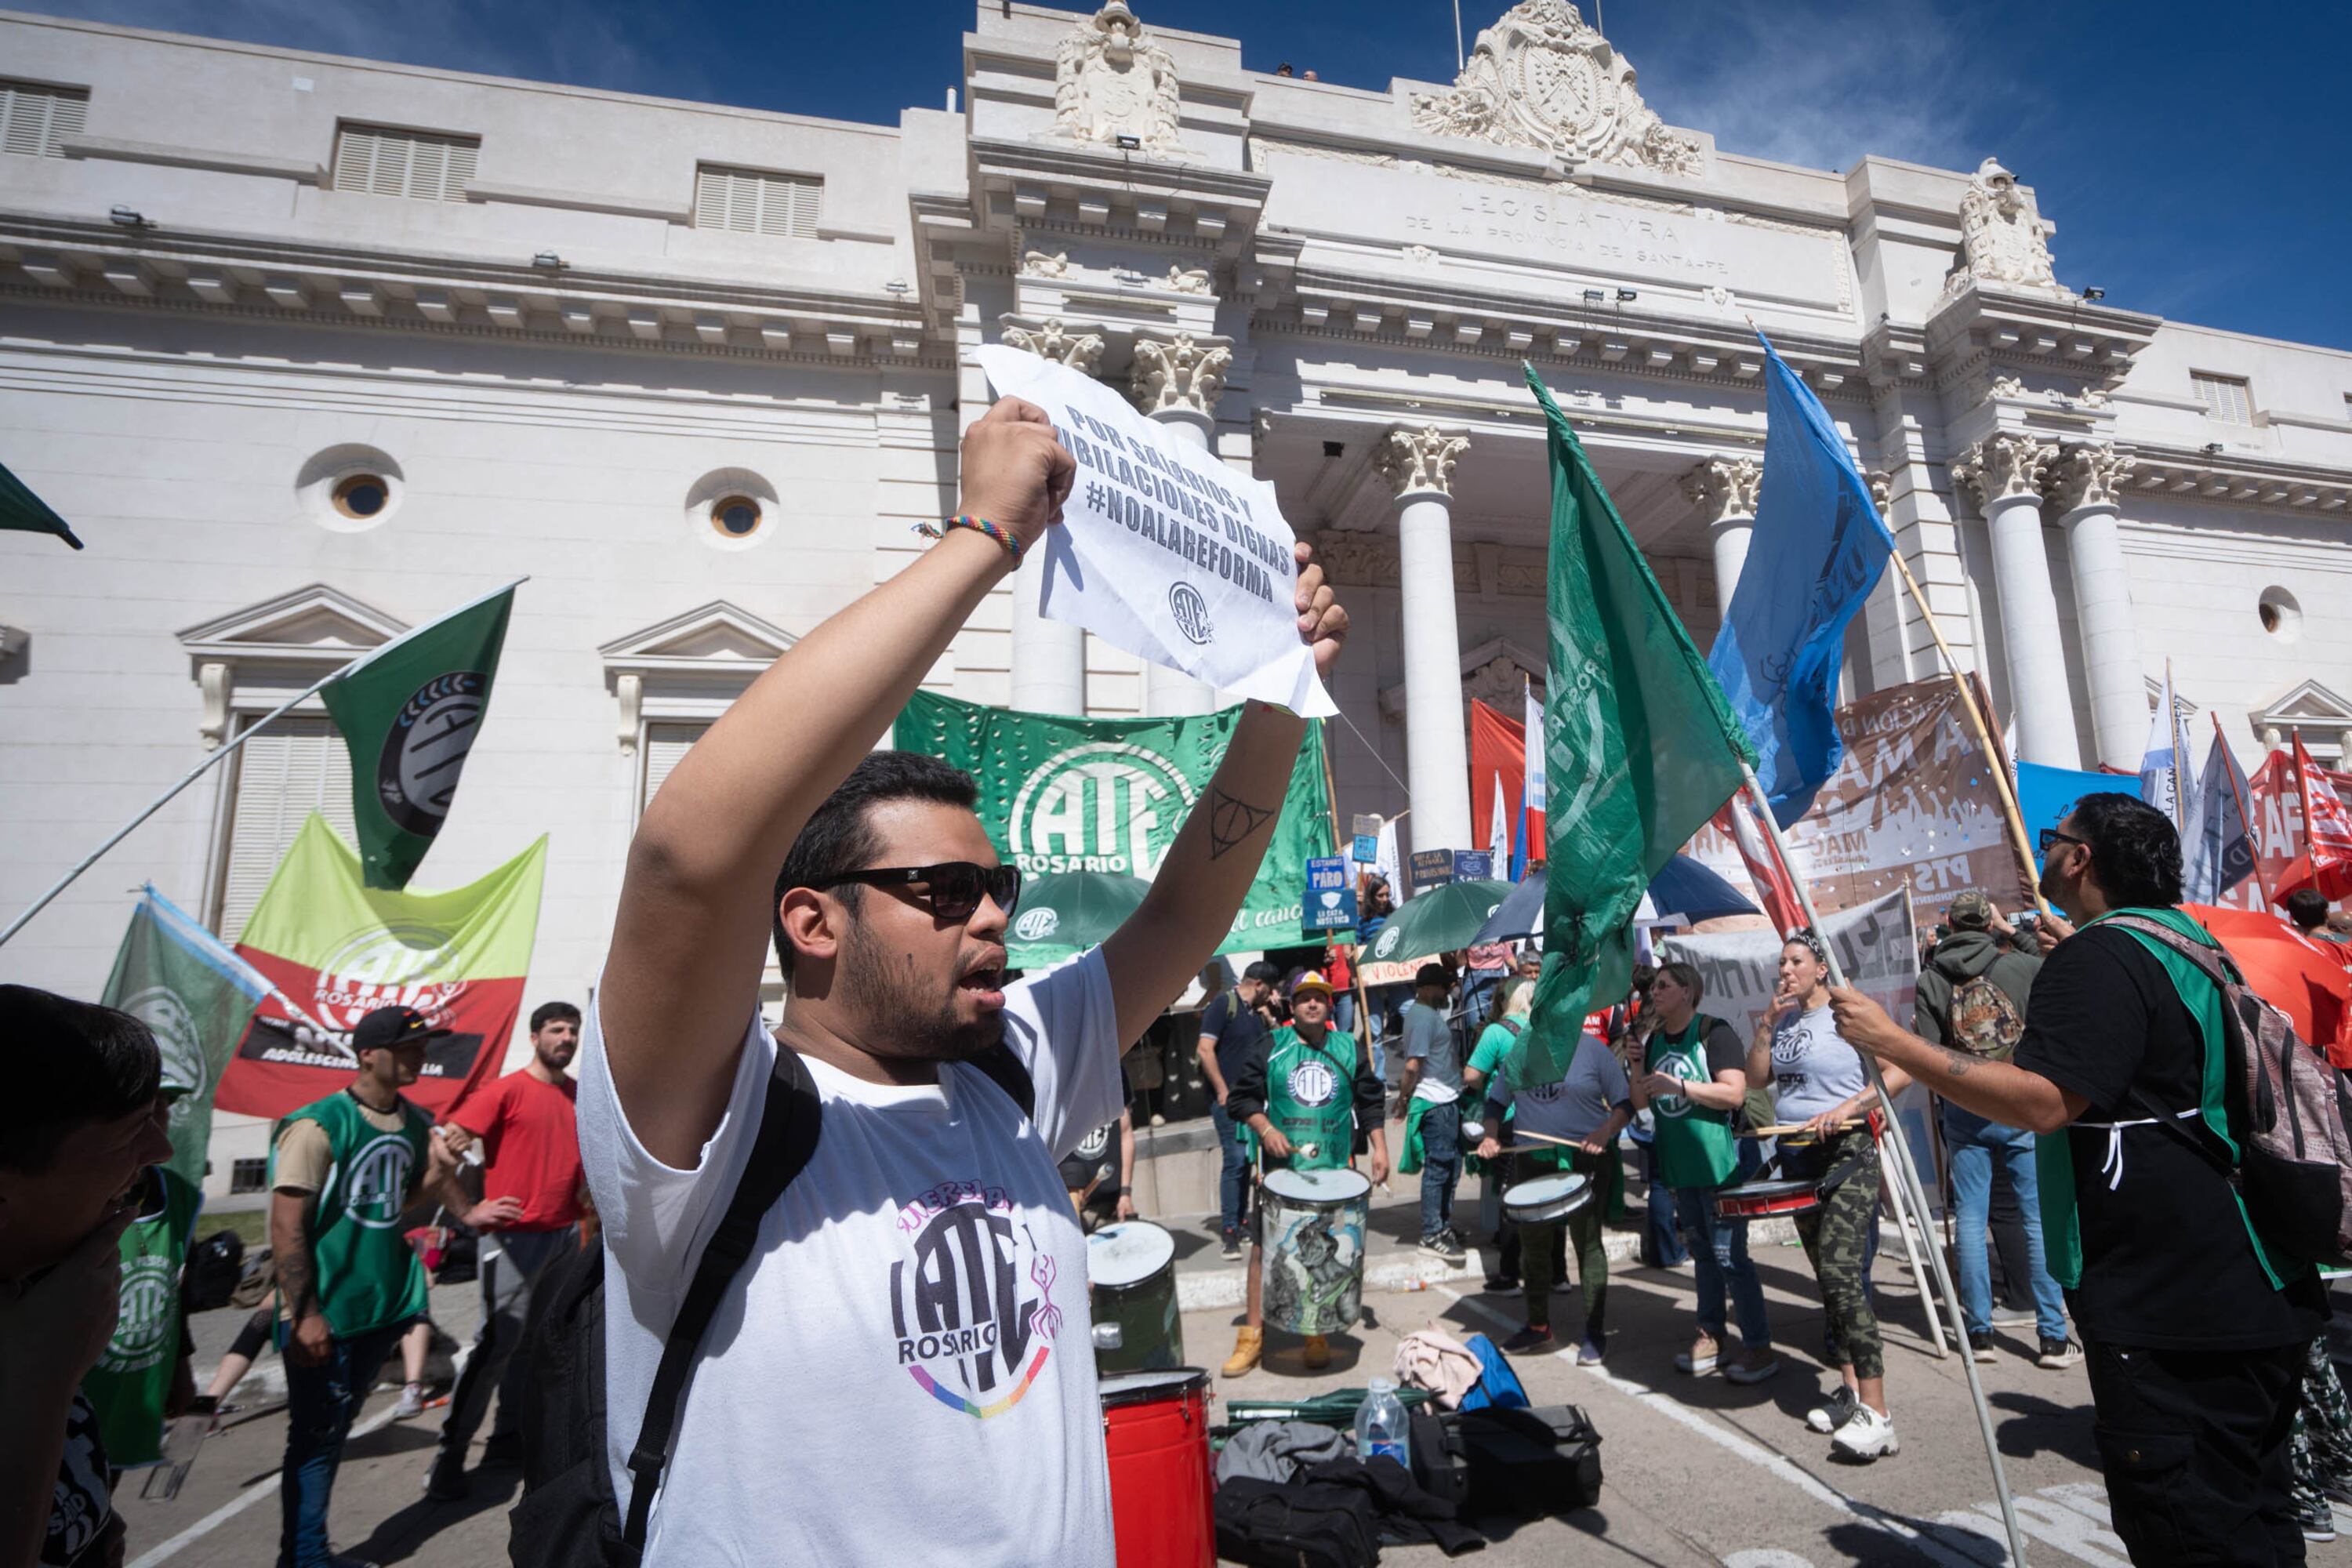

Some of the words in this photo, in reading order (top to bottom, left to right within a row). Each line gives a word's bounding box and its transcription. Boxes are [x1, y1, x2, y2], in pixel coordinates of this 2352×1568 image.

[1053, 424, 1219, 532] UBILACIONES
[1221, 511, 1290, 576] DIGNAS
[1065, 404, 1127, 452] POR
[1127, 436, 1239, 514] SALARIOS
[1237, 495, 1254, 522] Y
[1085, 481, 1273, 603] #NOALAREFORMA
[1015, 851, 1127, 876] ROSARIO
[1030, 762, 1170, 880] ATE
[1312, 870, 1343, 888] PARO
[313, 986, 398, 1010] ROSARIO
[1297, 1069, 1328, 1098] ATE
[350, 1144, 412, 1219] ATE
[914, 1202, 1038, 1392] ATE
